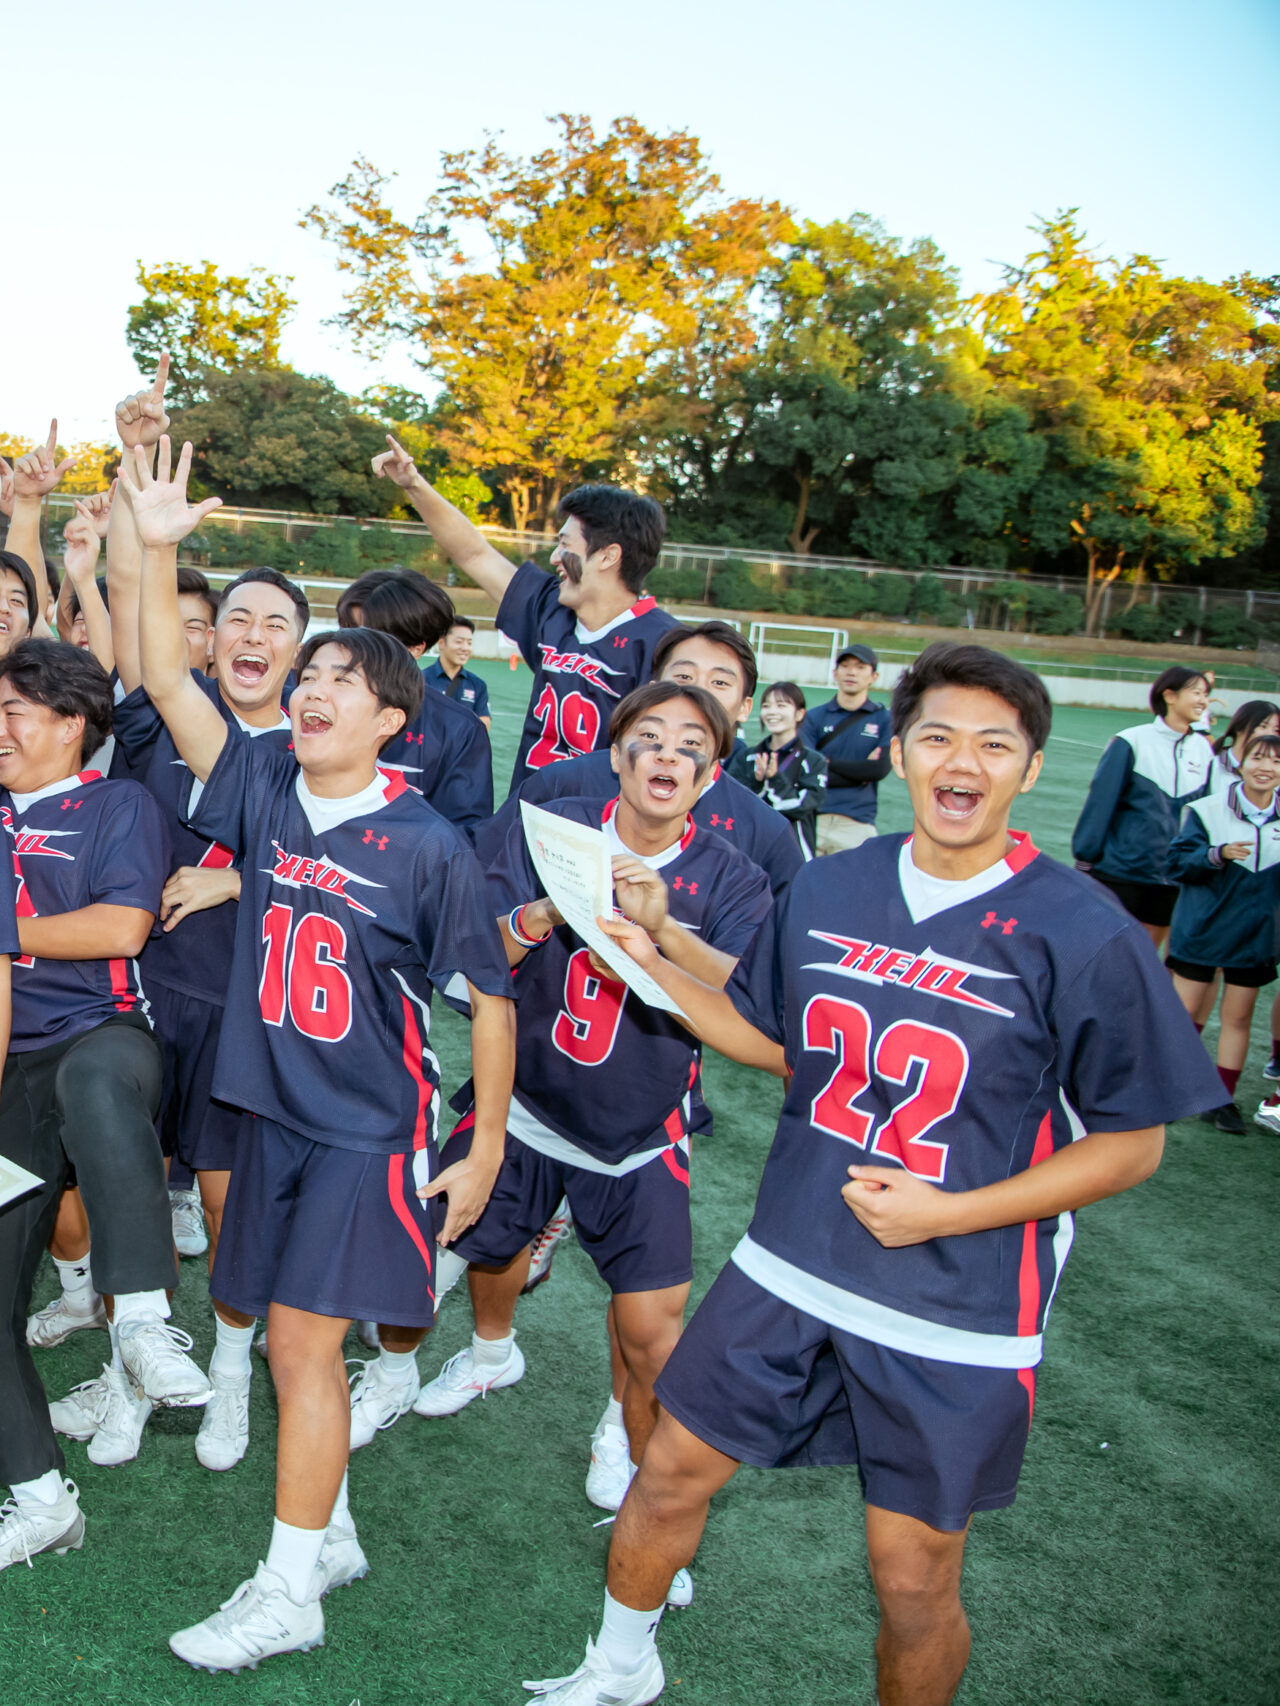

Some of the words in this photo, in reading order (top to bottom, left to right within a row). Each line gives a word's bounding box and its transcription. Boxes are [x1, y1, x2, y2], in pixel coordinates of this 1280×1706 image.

[525, 682, 601, 770] 29
[259, 901, 352, 1043] 16
[551, 947, 629, 1066] 9
[807, 929, 1016, 1019] KEIO
[802, 993, 969, 1183] 22
